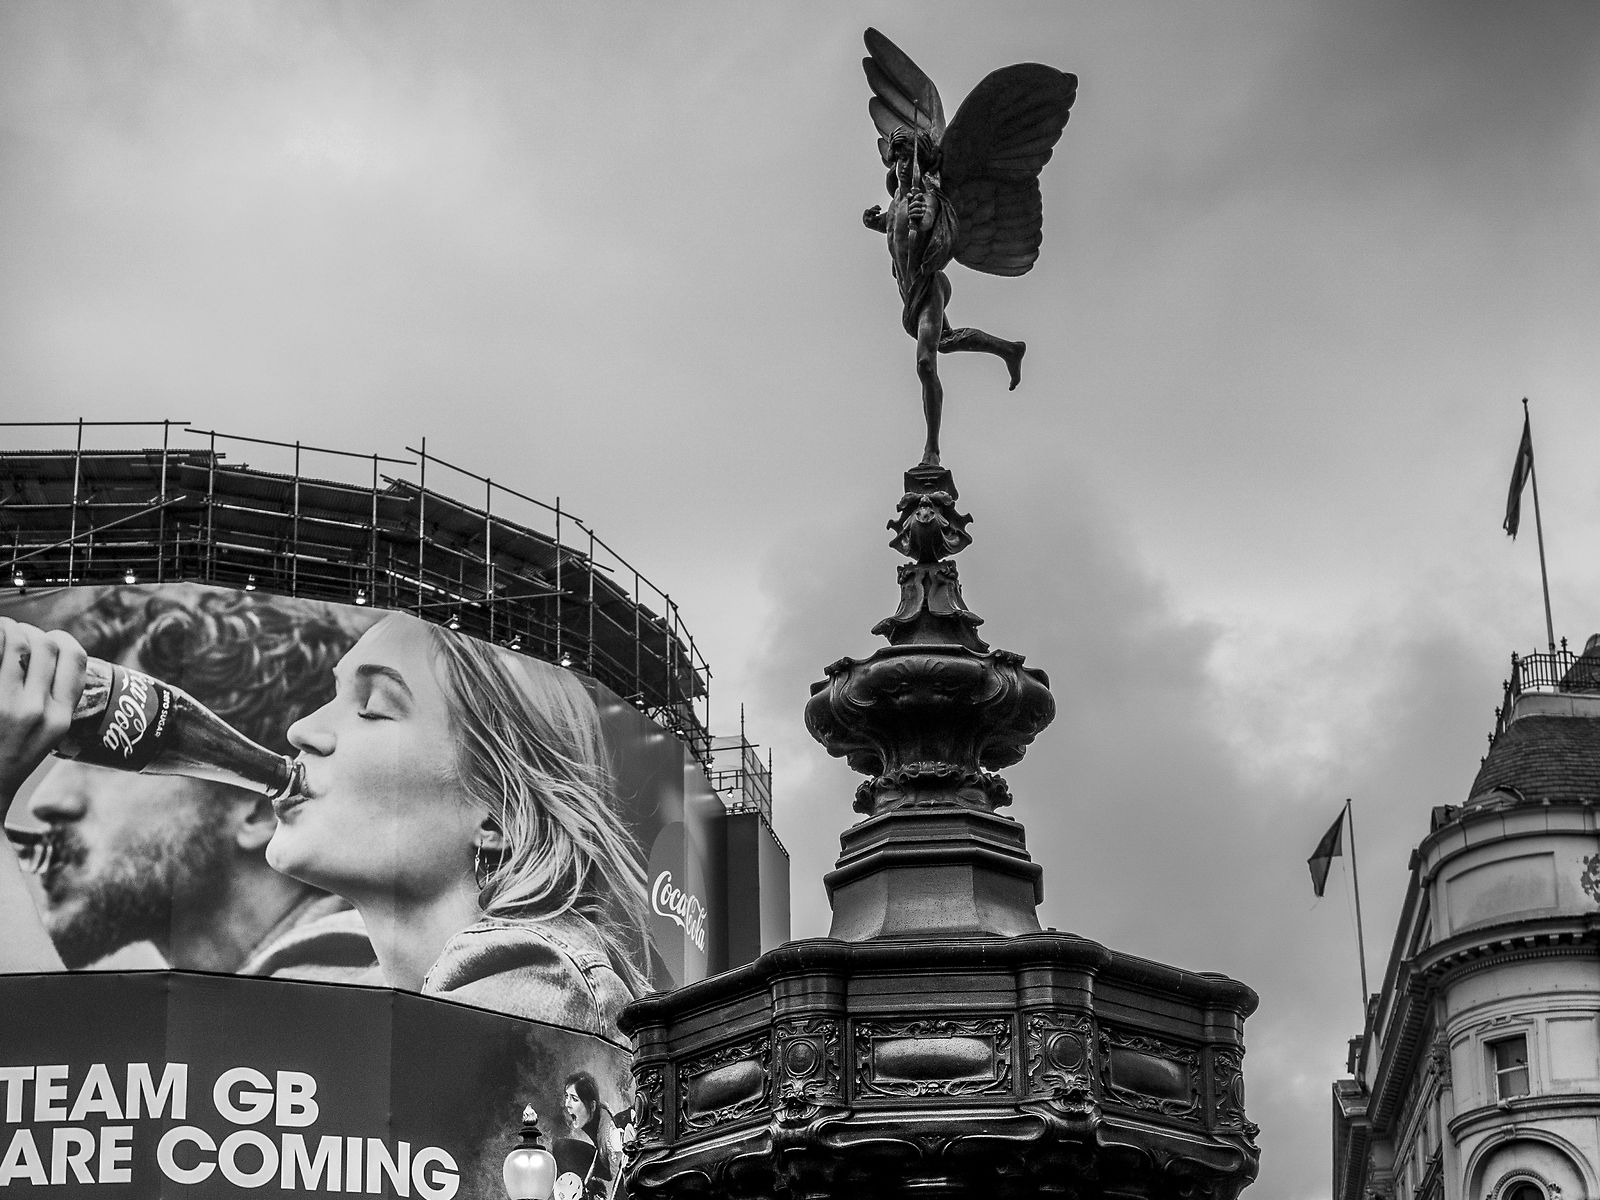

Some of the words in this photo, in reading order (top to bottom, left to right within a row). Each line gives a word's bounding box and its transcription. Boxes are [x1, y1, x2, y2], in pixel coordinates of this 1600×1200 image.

[103, 671, 153, 757] ca-Cola
[0, 1062, 188, 1123] TEAM
[213, 1067, 319, 1128] GB
[0, 1125, 134, 1187] ARE
